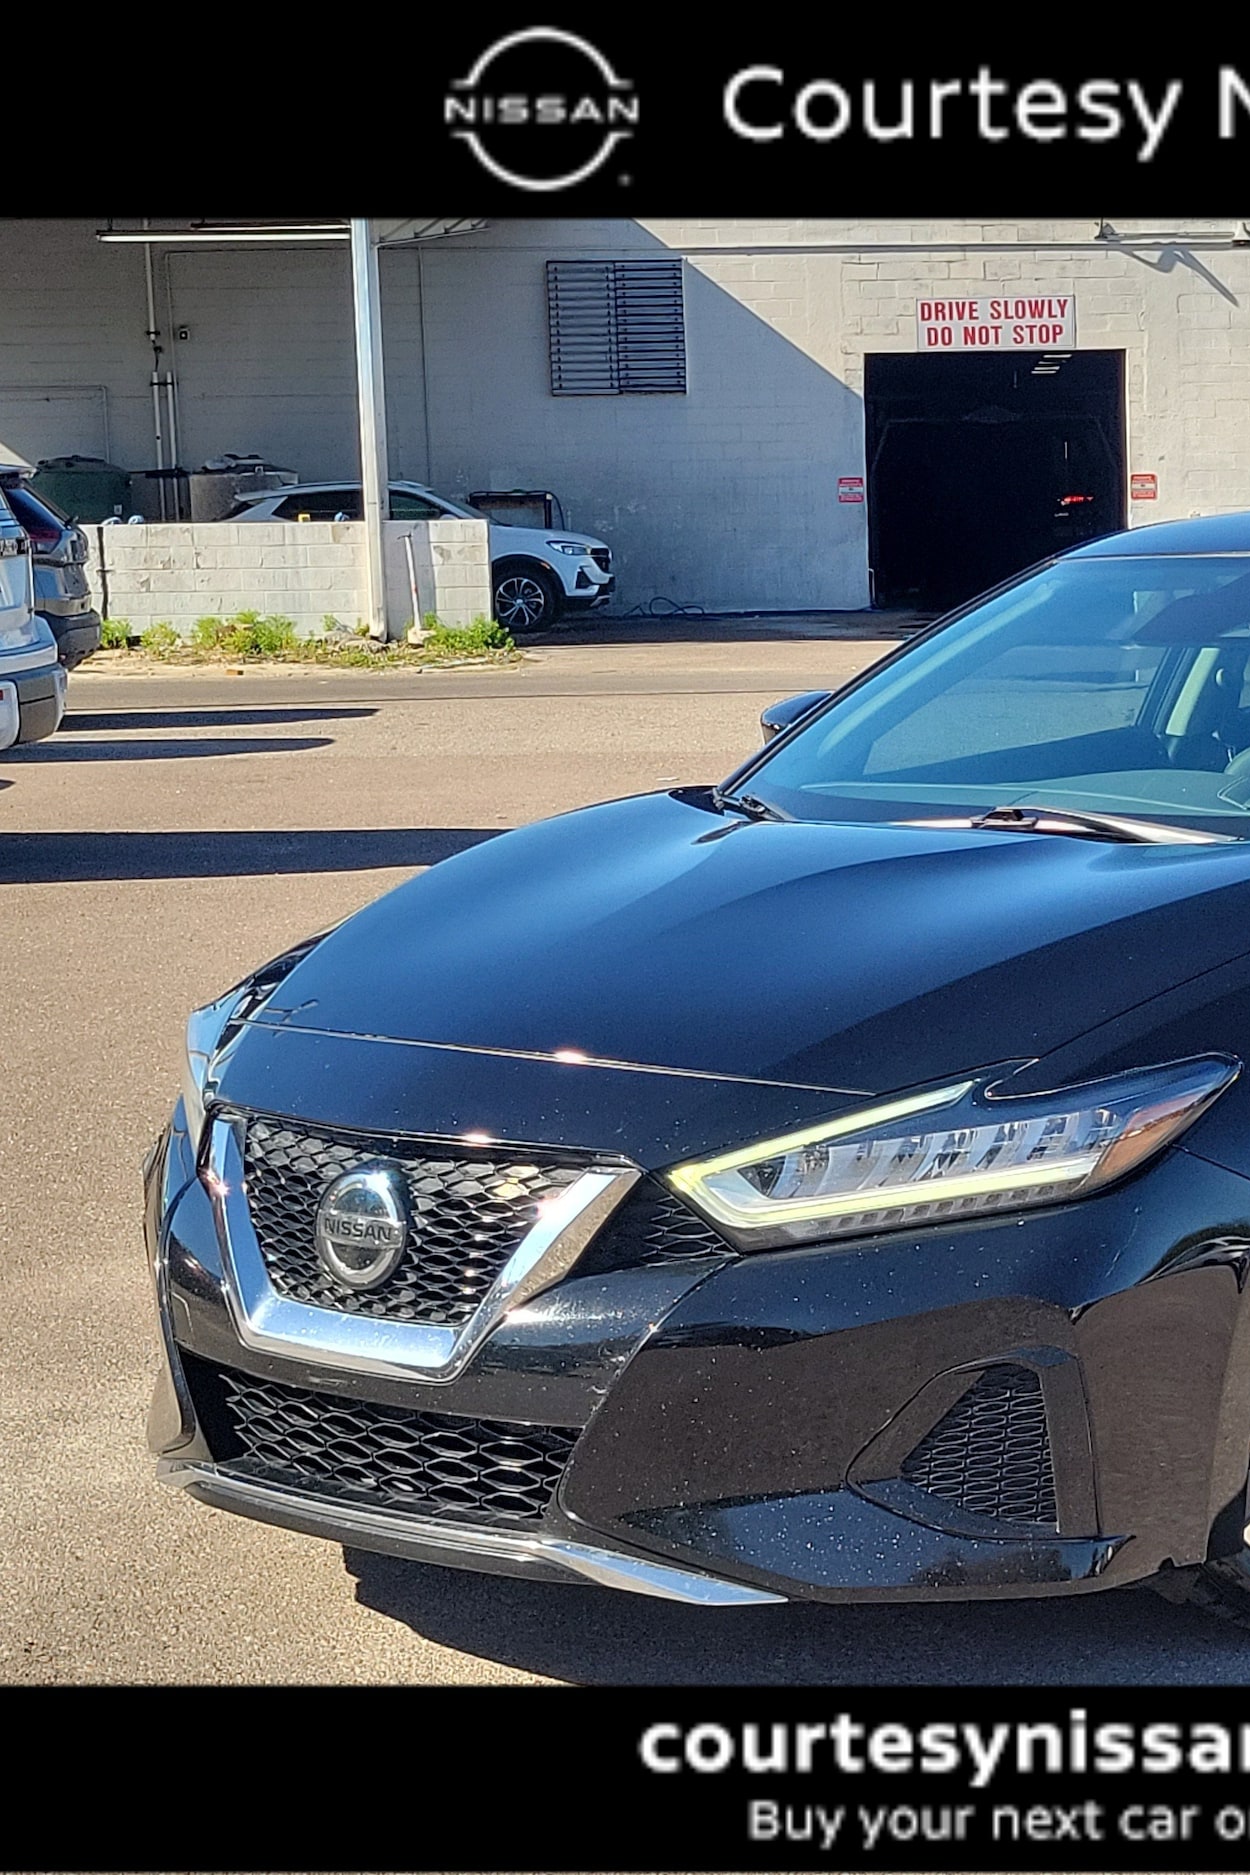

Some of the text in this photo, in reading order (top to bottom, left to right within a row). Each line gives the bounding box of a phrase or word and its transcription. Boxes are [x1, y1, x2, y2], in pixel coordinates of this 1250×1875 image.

[920, 299, 1069, 322] DRIVE SLOWLY
[926, 324, 1064, 347] DO NOT STOP
[324, 1217, 392, 1240] NISSAN
